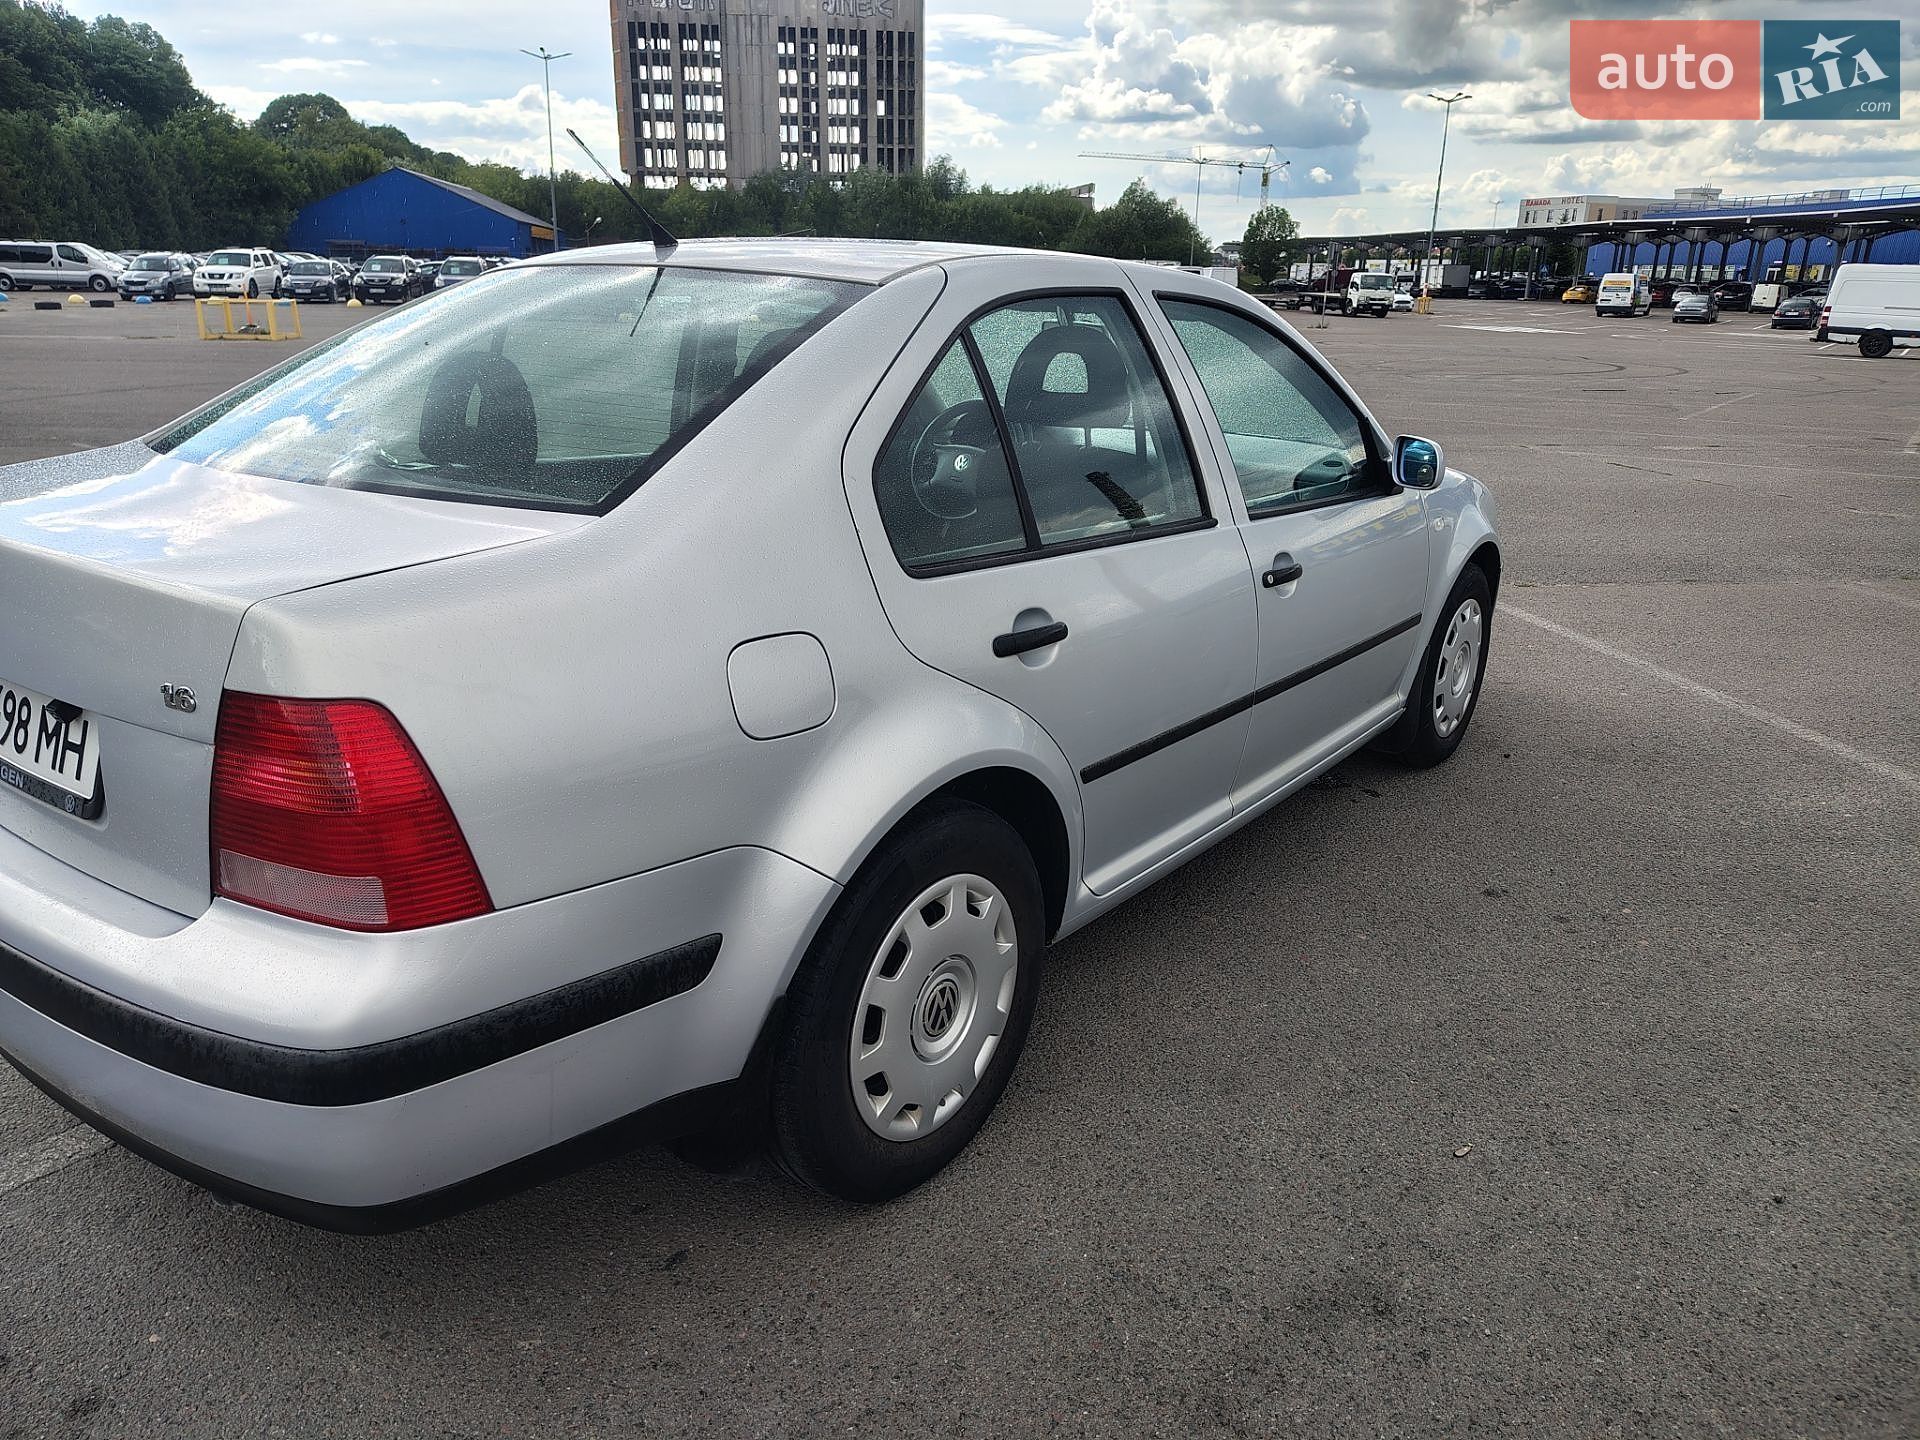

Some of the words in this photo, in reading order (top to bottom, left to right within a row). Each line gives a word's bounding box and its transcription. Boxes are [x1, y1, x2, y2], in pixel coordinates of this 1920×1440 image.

[1561, 195, 1585, 205] HOTEL
[0, 685, 31, 754] 98
[34, 704, 89, 781] MH
[0, 765, 24, 788] GEN
